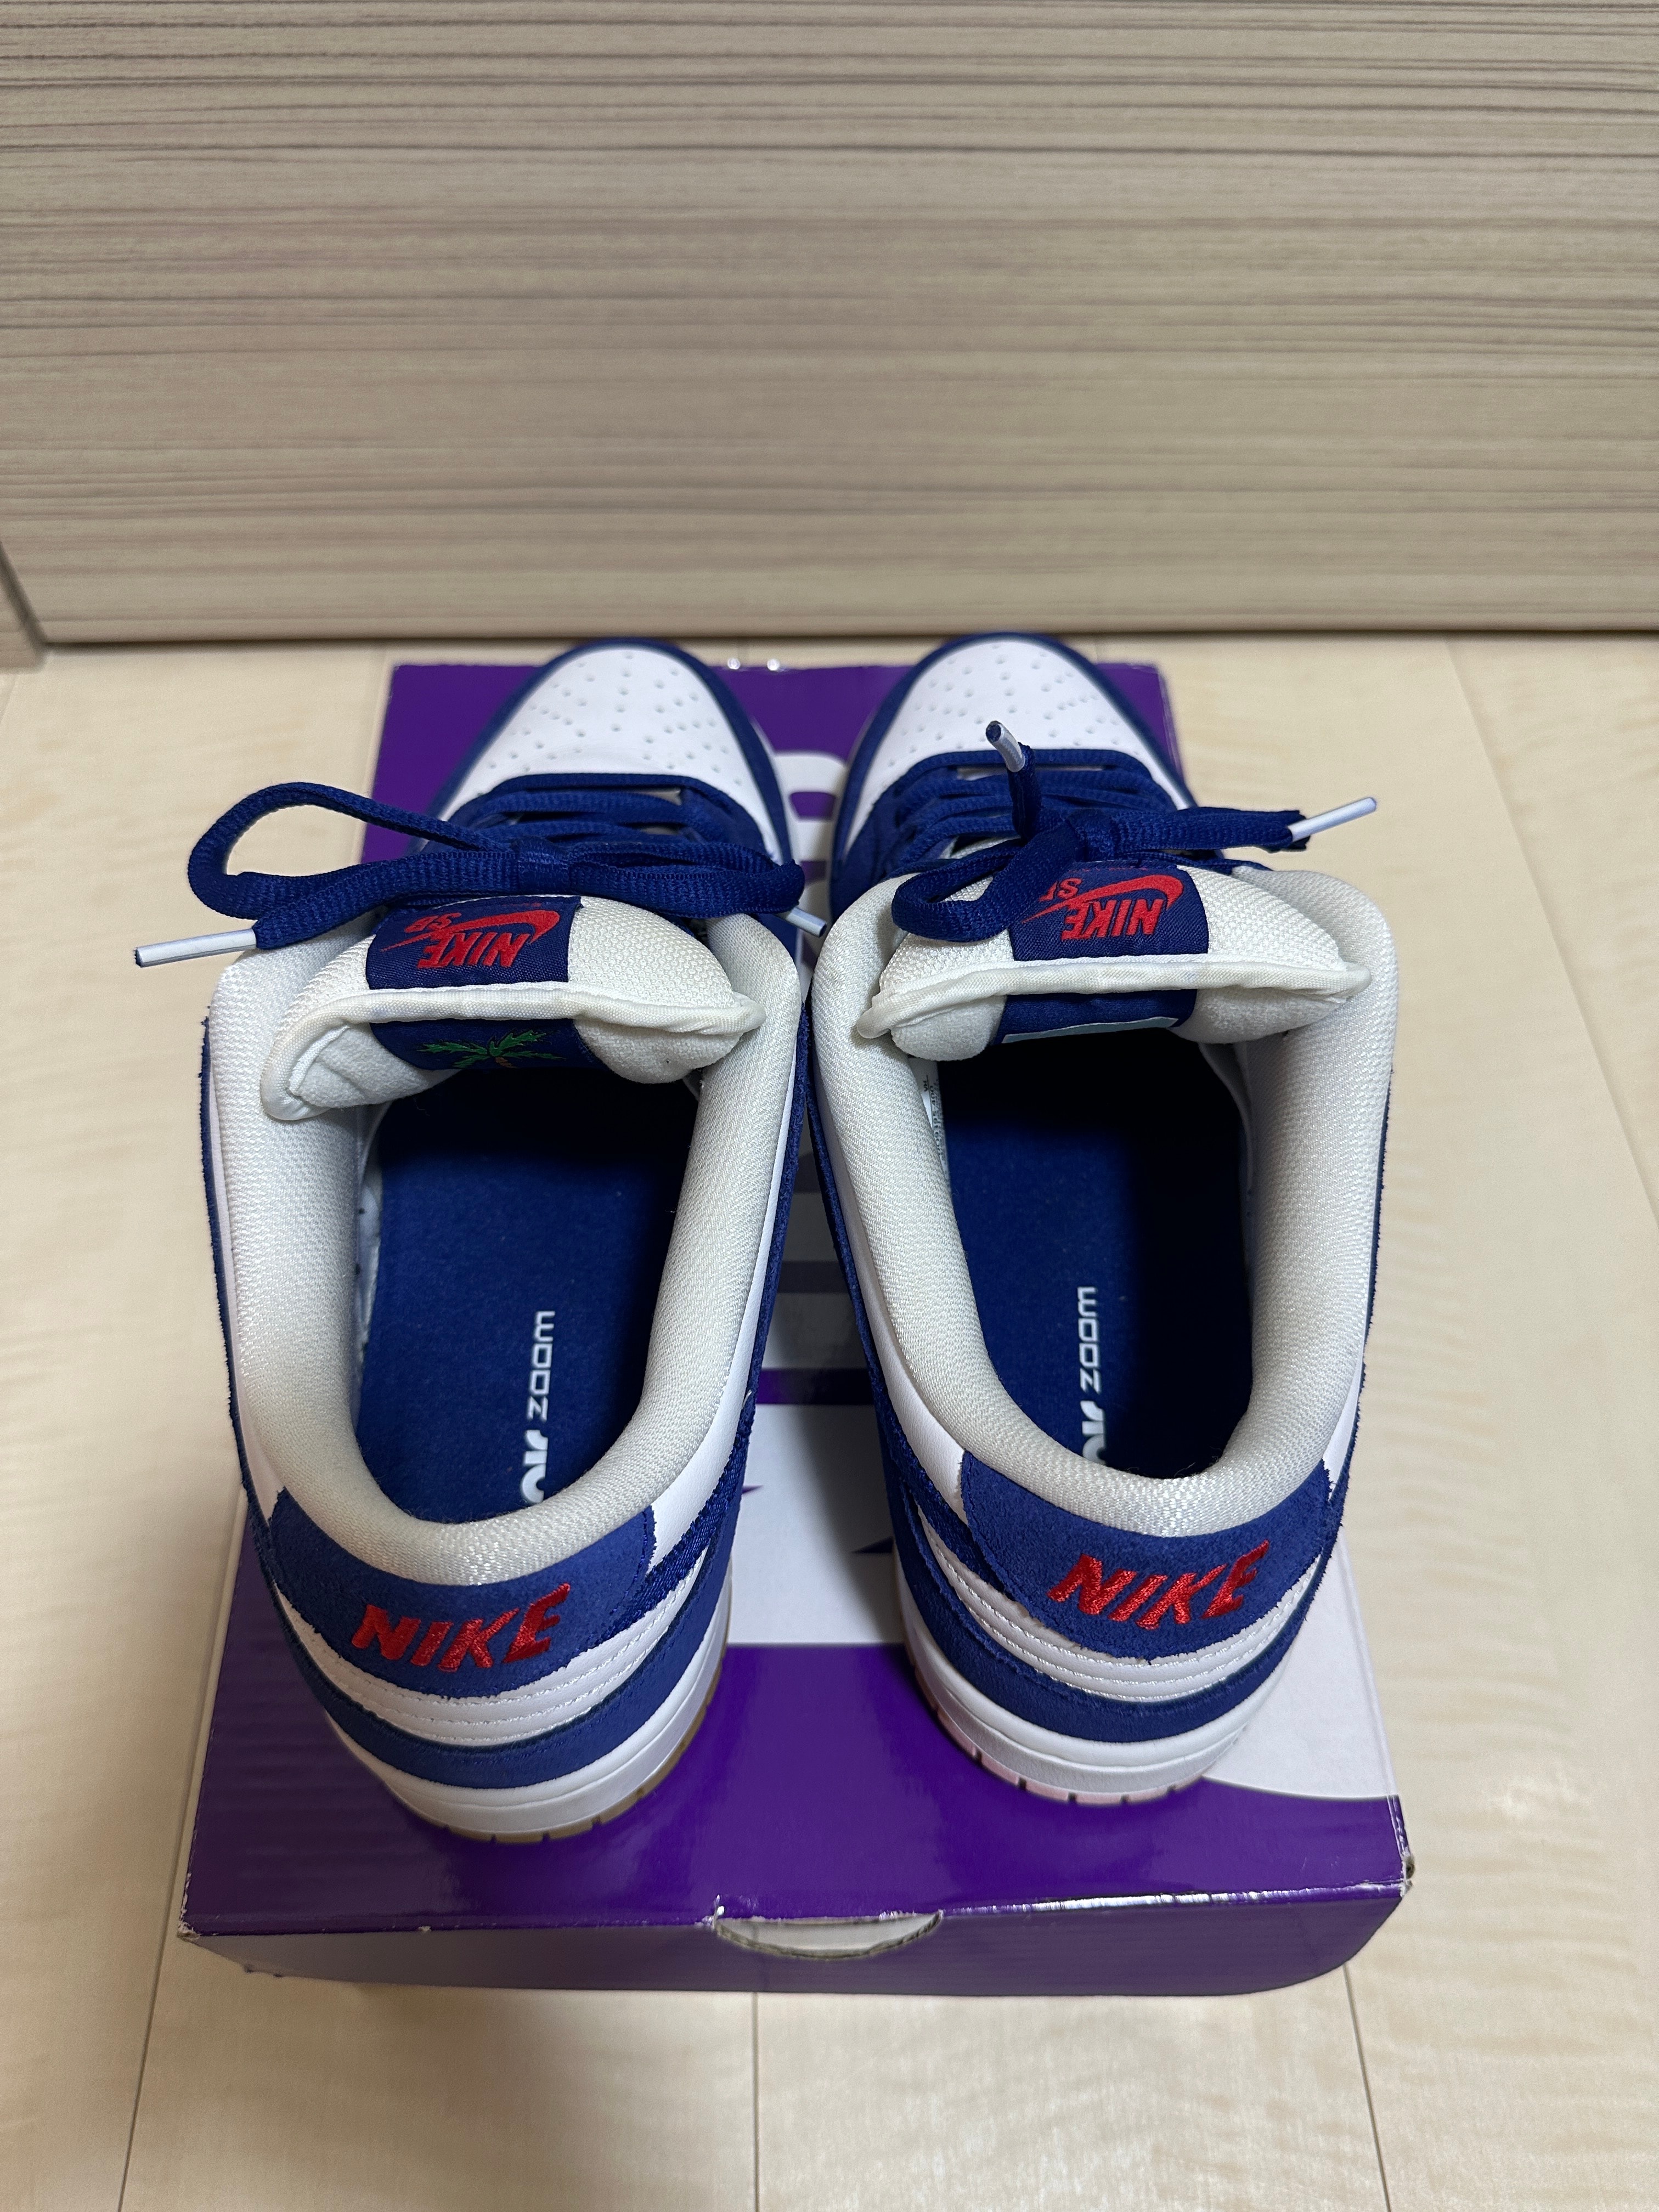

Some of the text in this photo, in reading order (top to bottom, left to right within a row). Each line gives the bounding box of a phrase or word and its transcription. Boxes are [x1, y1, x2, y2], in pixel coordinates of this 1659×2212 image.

[417, 932, 530, 969] NIKE
[1061, 899, 1164, 940] NIKE
[1047, 1539, 1269, 1630] NIKE
[352, 1582, 571, 1673] NIKE
